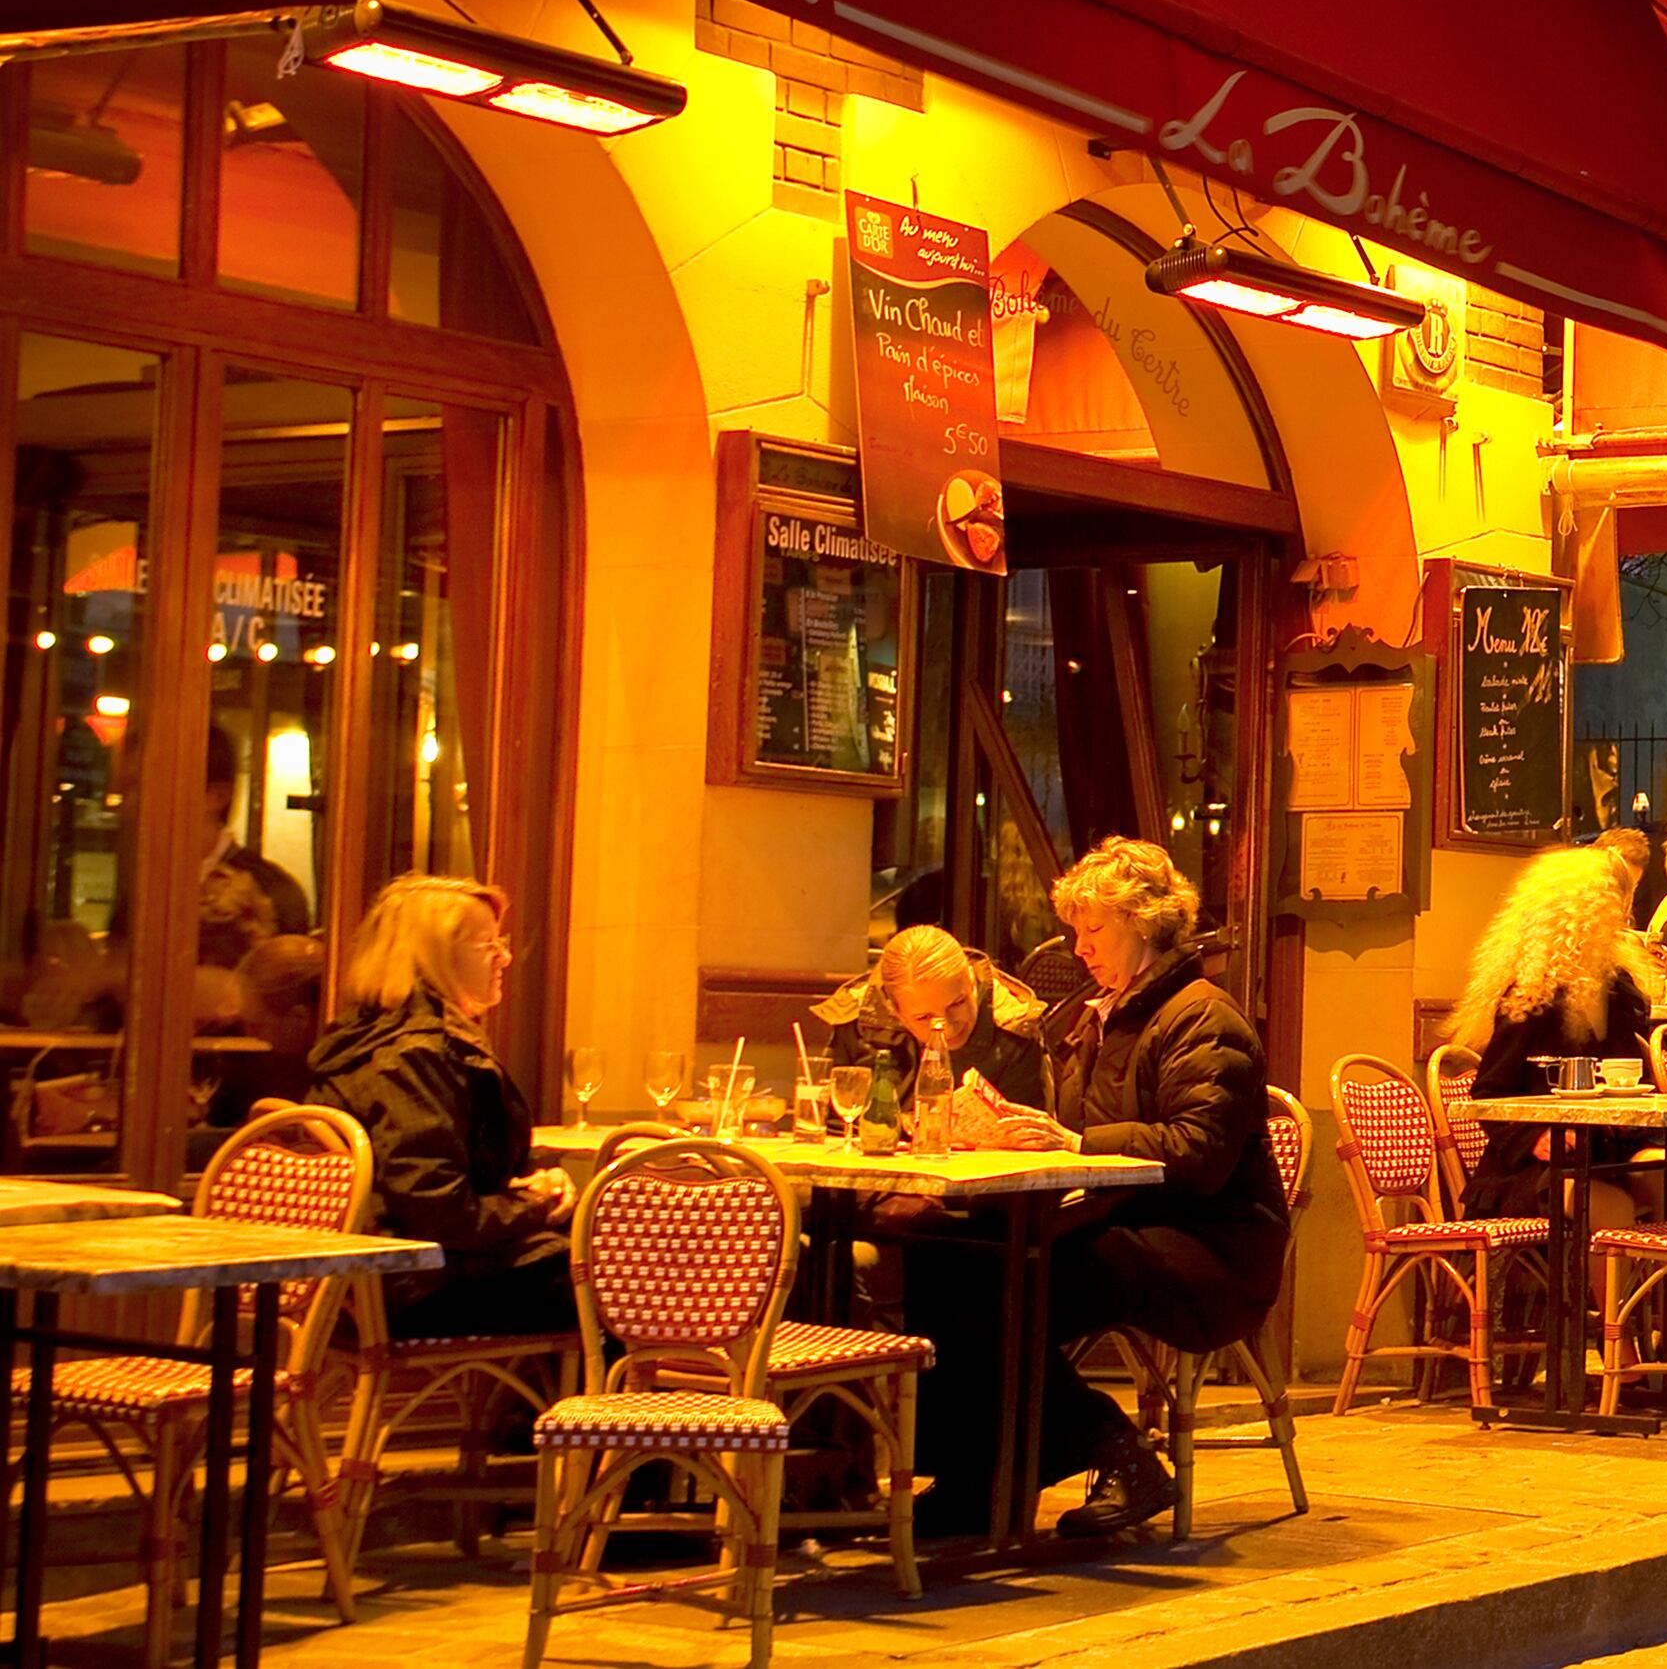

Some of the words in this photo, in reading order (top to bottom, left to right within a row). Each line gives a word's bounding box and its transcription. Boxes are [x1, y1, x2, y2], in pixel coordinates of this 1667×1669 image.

[1158, 70, 1255, 175] La
[858, 218, 891, 241] CARTE
[863, 235, 889, 254] D'OR
[899, 215, 919, 236] Au
[922, 228, 959, 248] menu
[868, 288, 903, 326] Vin
[905, 297, 963, 342] Chaud
[967, 318, 985, 348] et
[1092, 296, 1121, 342] du
[875, 331, 911, 367] Pain
[916, 345, 980, 389] d'épices
[903, 374, 949, 414] Maison
[943, 422, 989, 456] 5€50
[768, 515, 811, 552] Salle
[214, 570, 326, 618] CLIMATISÉE
[1467, 606, 1517, 654] Menu
